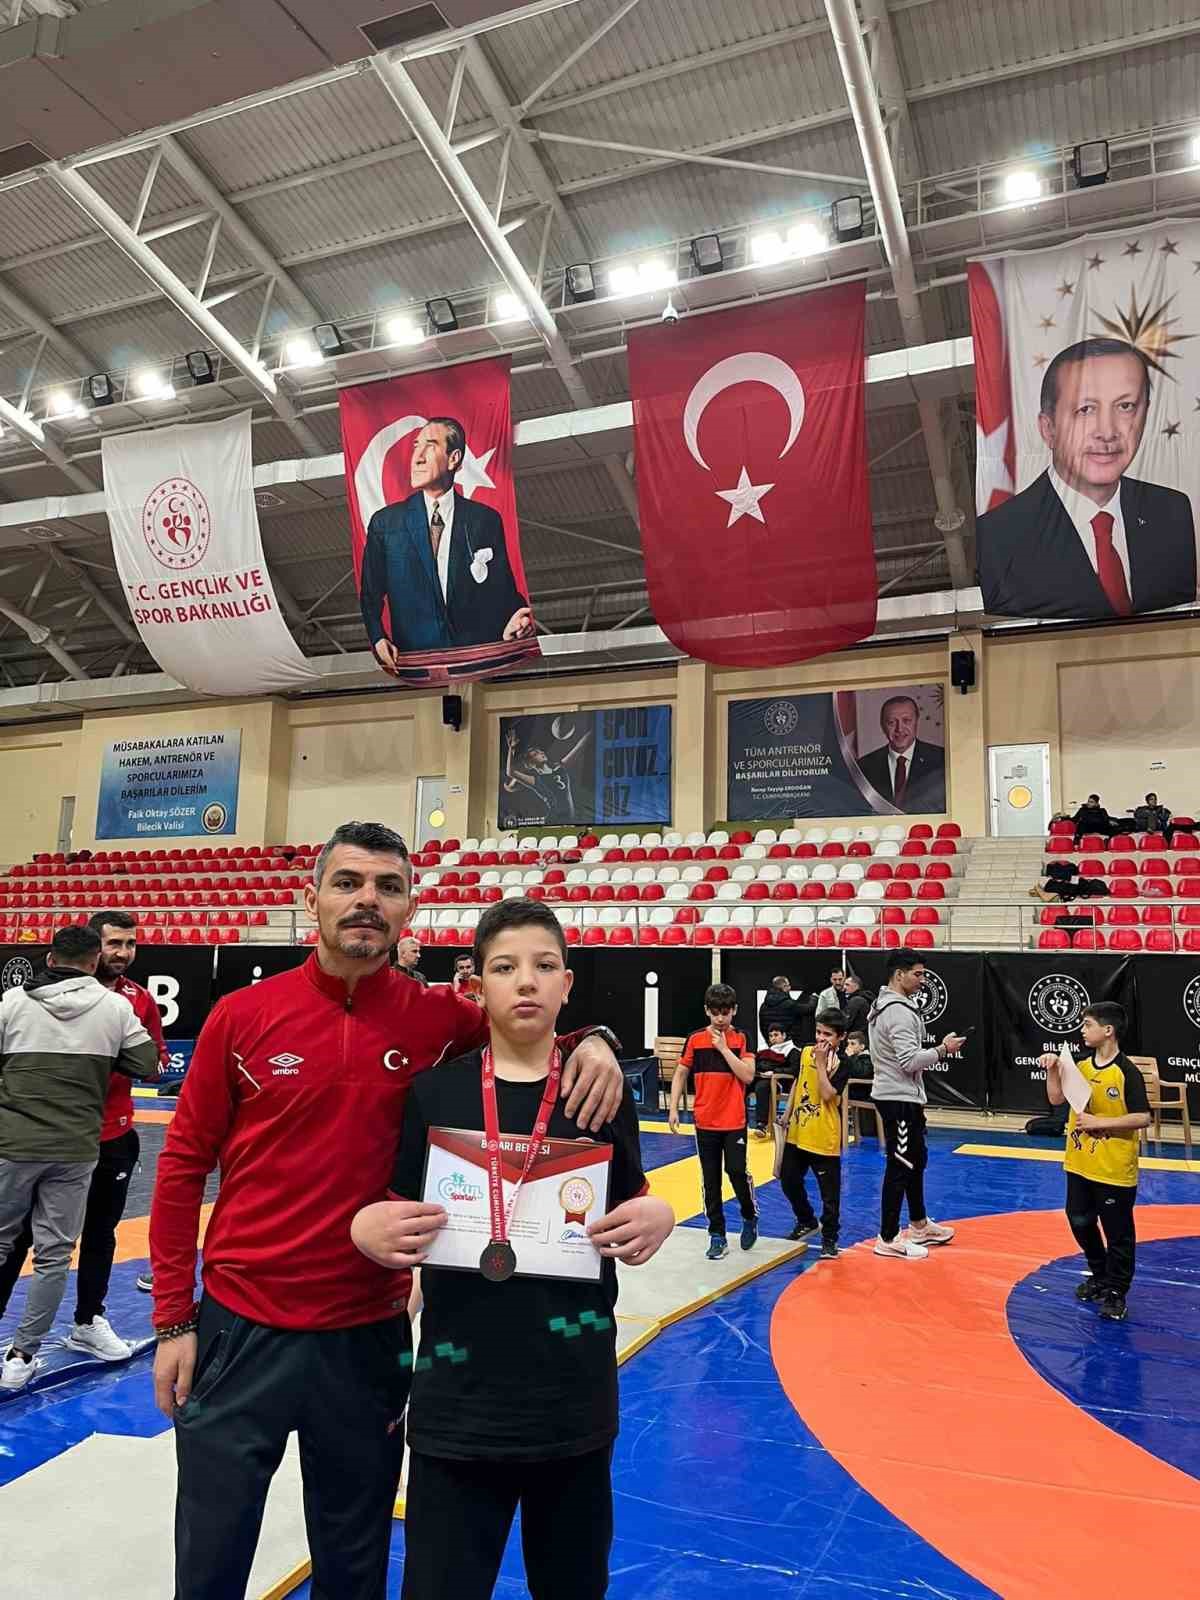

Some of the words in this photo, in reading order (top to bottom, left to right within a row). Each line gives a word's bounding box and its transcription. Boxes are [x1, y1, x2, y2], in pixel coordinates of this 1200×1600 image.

[159, 574, 232, 600] GENÇLİK
[236, 569, 263, 590] VE
[134, 608, 174, 624] SPOR
[176, 592, 272, 622] BAKANLIĞI
[113, 739, 184, 752] MÜSABAKALARA
[186, 735, 224, 747] KATILAN
[744, 745, 766, 757] TÜM
[768, 743, 821, 755] ANTRENÖR
[119, 757, 152, 769] HAKEM,
[154, 752, 201, 765] ANTRENÖR
[204, 752, 215, 761] VE
[734, 761, 745, 770] VE
[747, 756, 832, 769] SPORCULARIMIZA
[127, 769, 204, 783] SPORCULARIMIZA
[735, 770, 780, 781] BAŞARILAR
[121, 787, 169, 801] BAŞARILAR
[170, 785, 207, 797] DİLERİM
[145, 808, 168, 820] Oktay
[169, 806, 196, 817] SÖZER
[137, 822, 162, 832] Bilecik
[163, 820, 184, 831] Valisi
[272, 1067, 299, 1076] umbro
